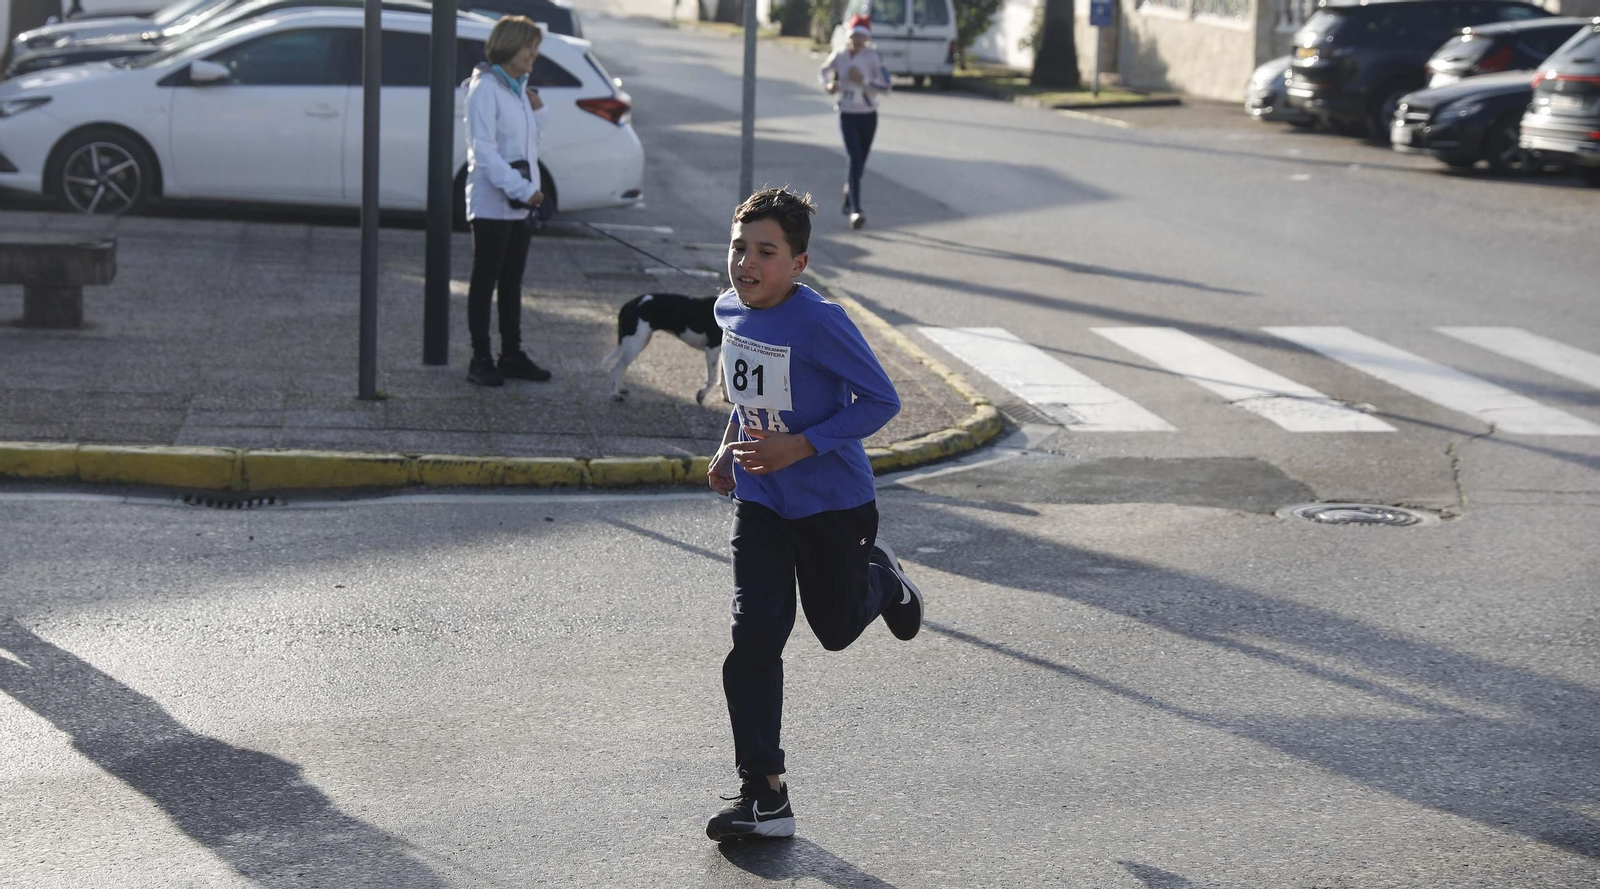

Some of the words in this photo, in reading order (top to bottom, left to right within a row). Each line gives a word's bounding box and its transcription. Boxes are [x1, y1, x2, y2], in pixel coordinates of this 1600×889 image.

[757, 348, 785, 358] FRONTERA
[733, 358, 764, 396] 81
[739, 405, 790, 432] SA
